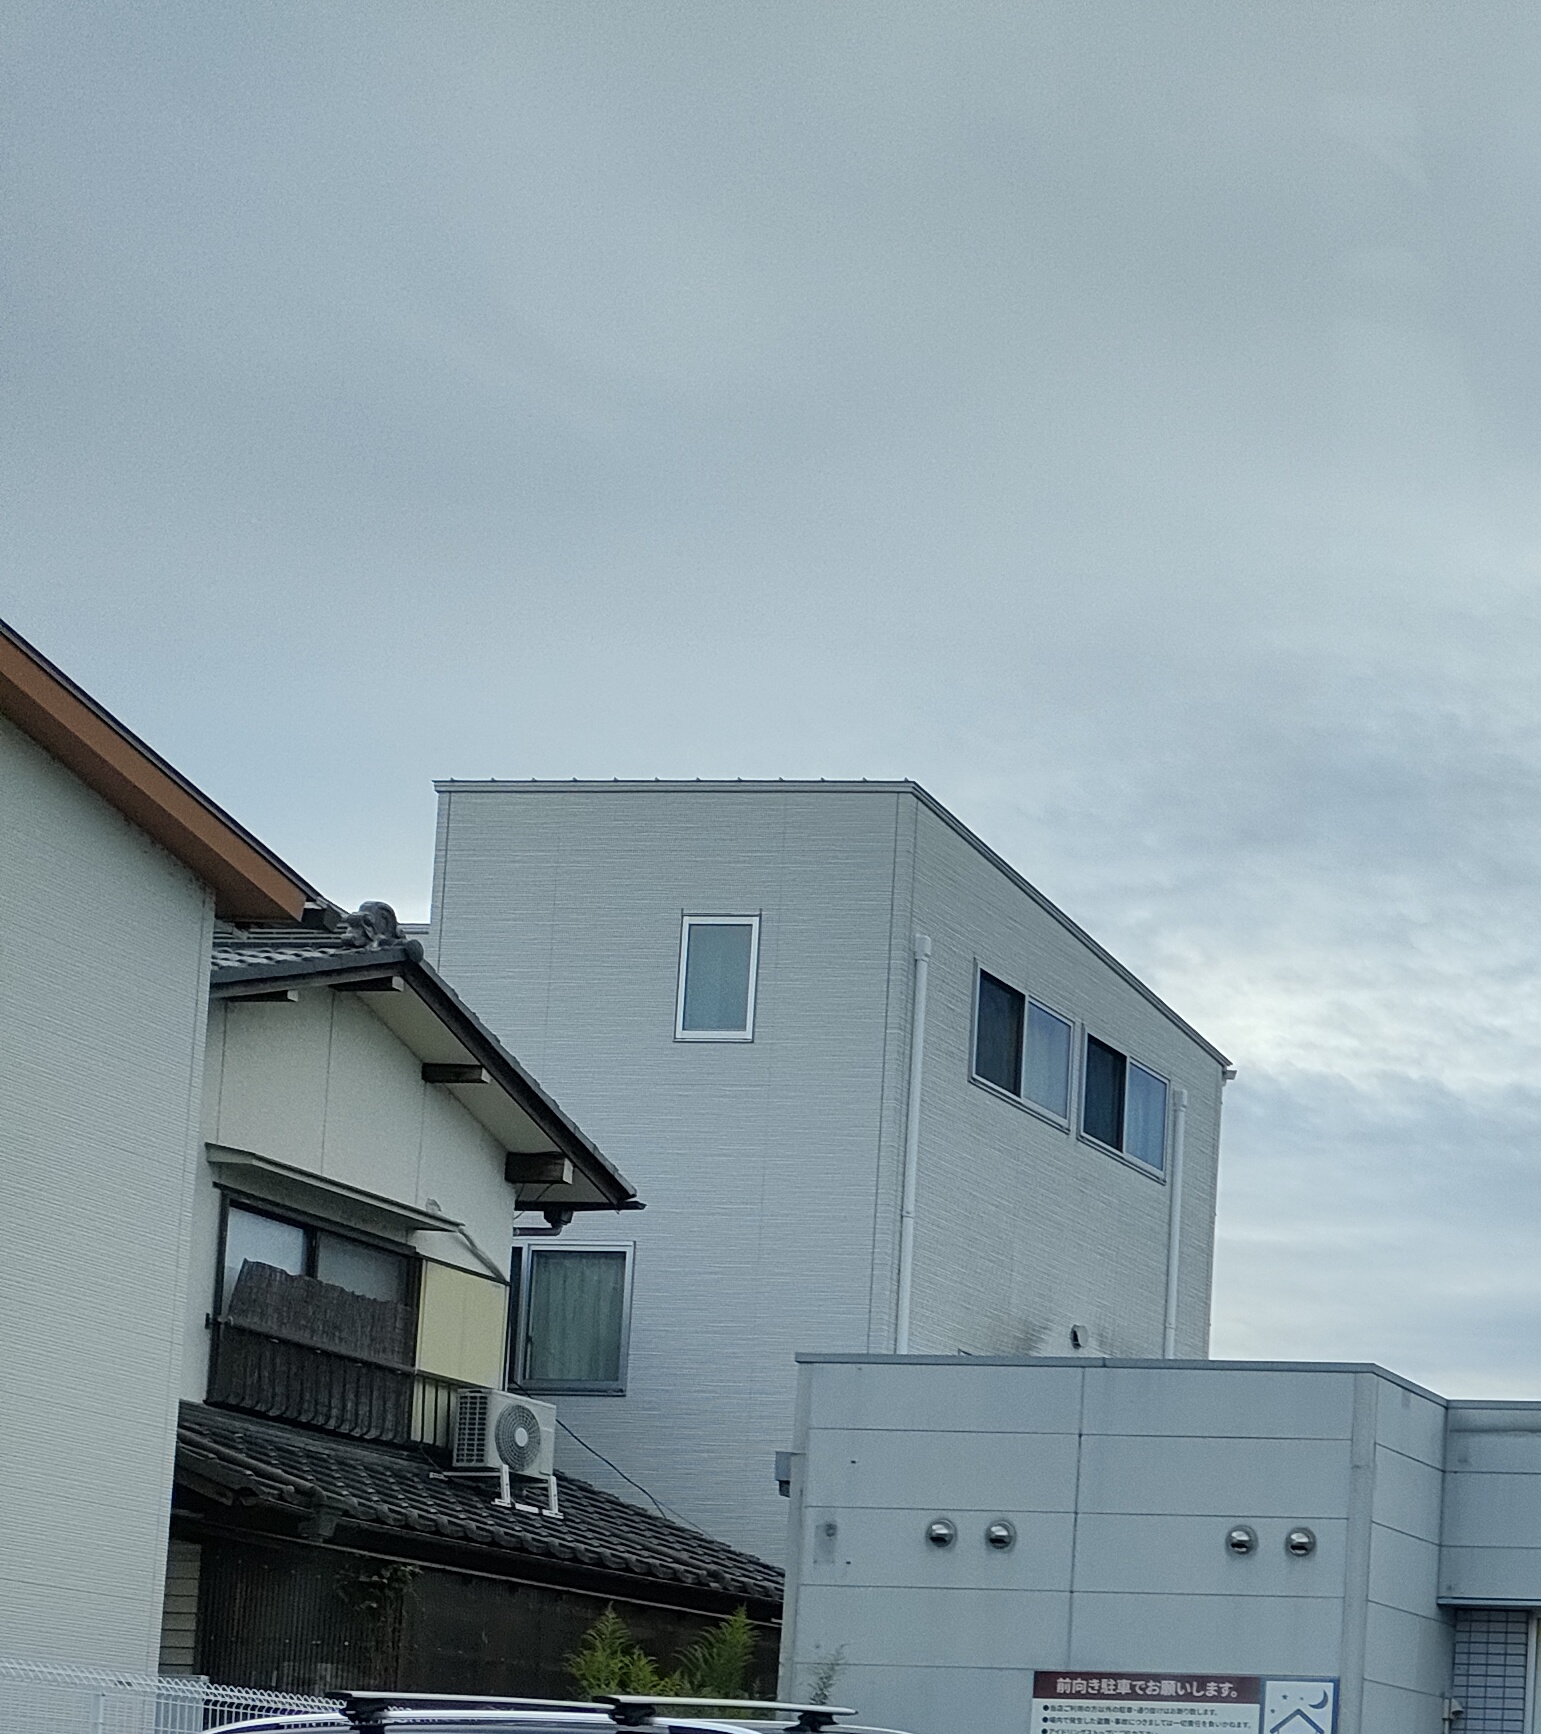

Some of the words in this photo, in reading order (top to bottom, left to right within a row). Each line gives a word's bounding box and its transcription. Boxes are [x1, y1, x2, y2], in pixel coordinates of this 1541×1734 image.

[1056, 1677, 1238, 1698] 前向き駐車でお願いします。
